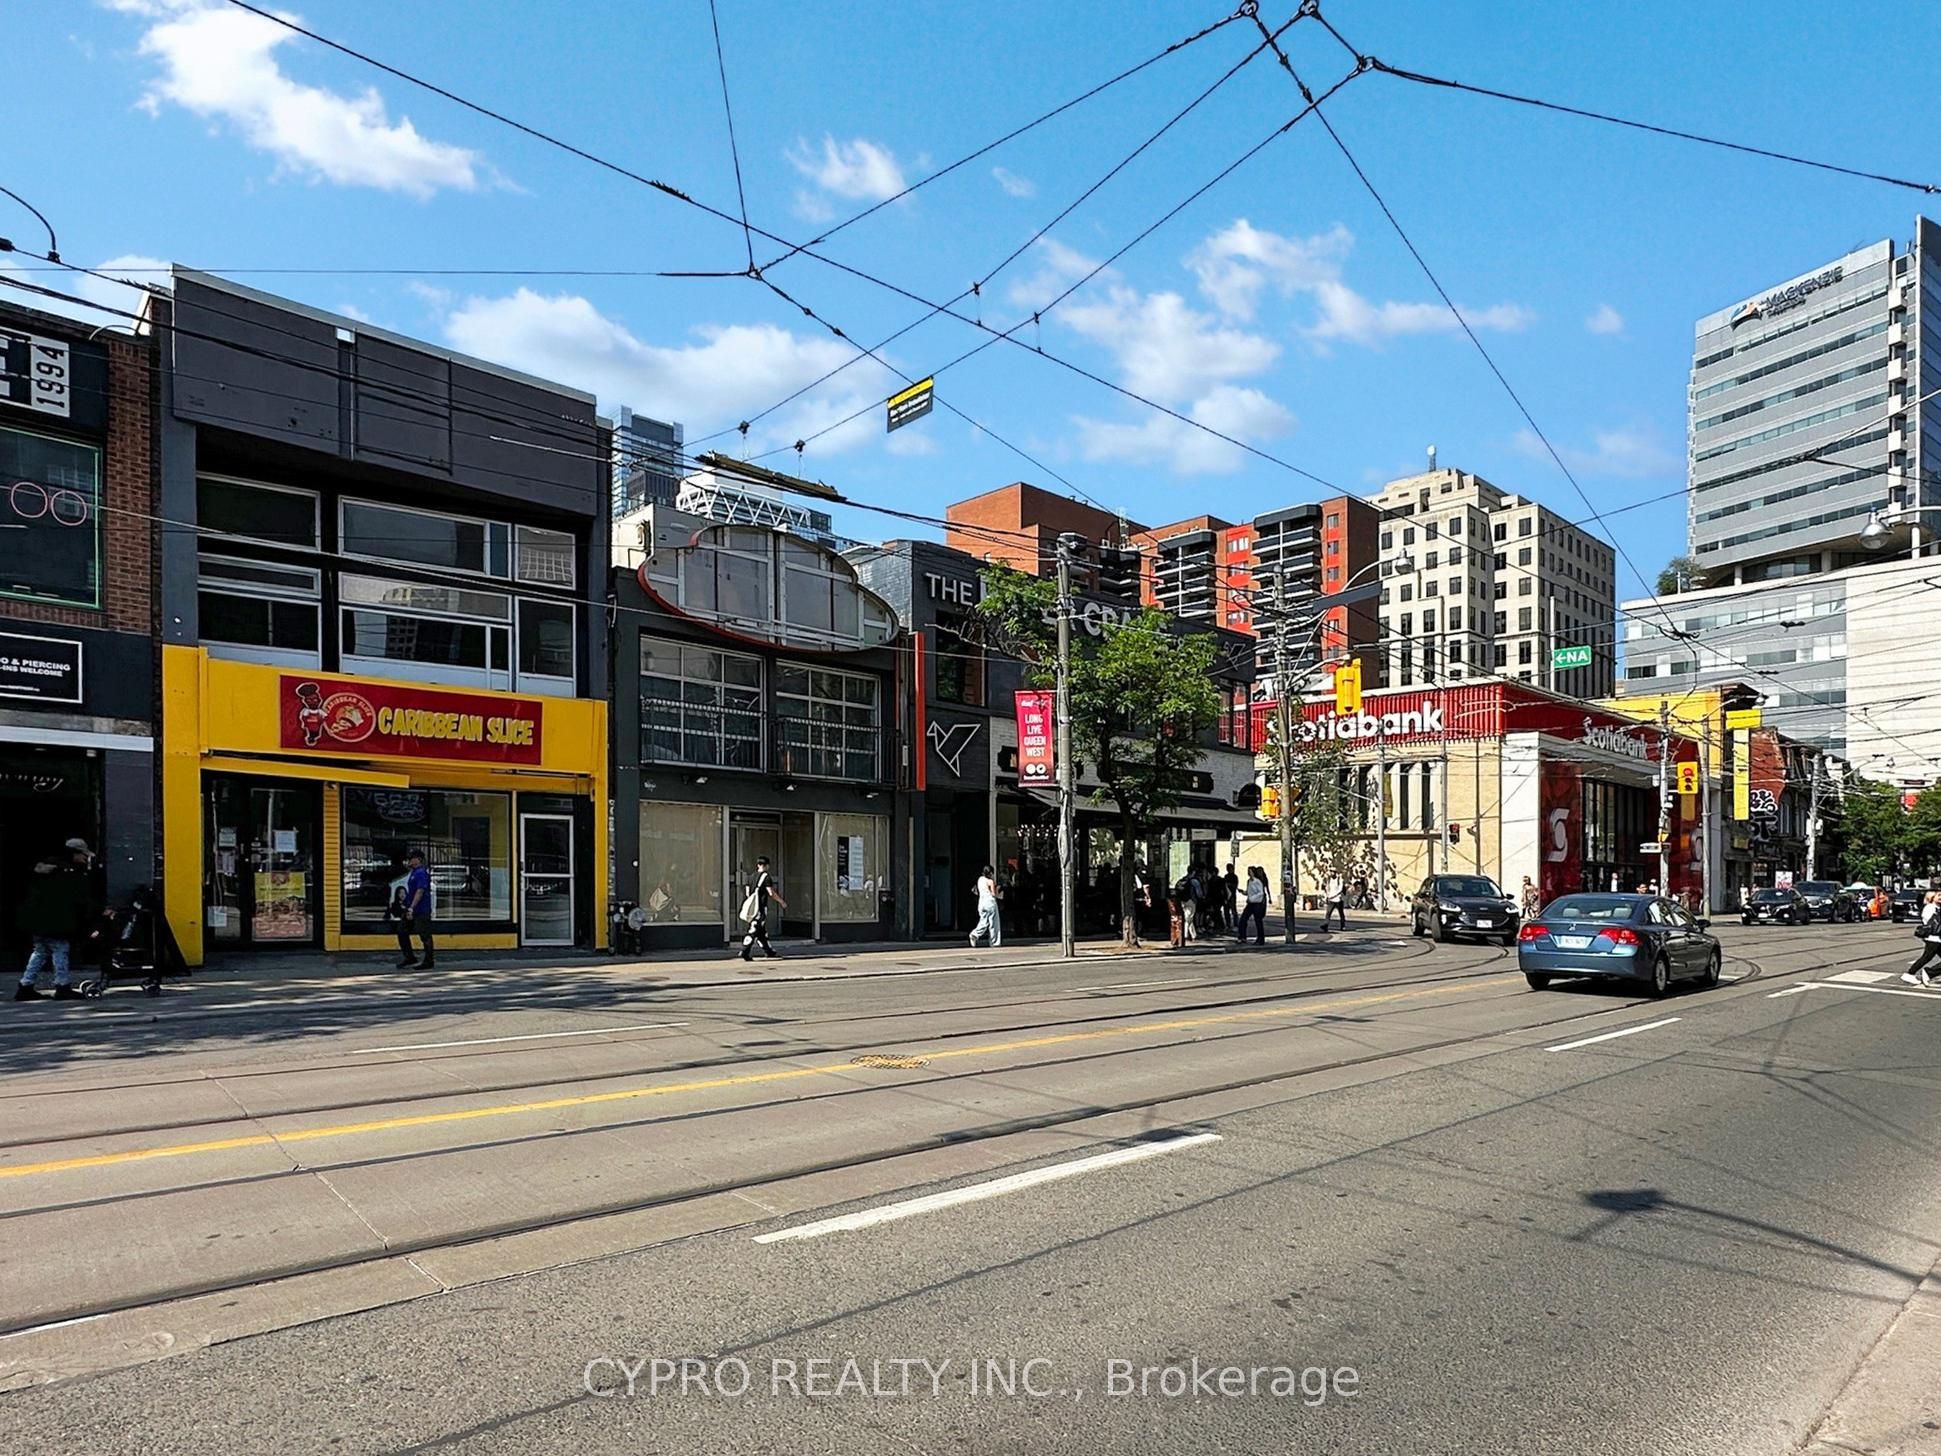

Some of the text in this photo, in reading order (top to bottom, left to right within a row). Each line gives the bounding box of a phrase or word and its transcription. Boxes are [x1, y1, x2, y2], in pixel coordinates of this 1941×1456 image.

[35, 345, 66, 408] 1994
[924, 572, 974, 607] THE
[1567, 650, 1588, 664] NA
[22, 659, 71, 671] PIERCING
[20, 666, 63, 677] WELCOME
[1024, 713, 1044, 724] LONG
[377, 706, 535, 746] CARIBBEAN SLICE
[1027, 725, 1043, 735] LIVE
[1023, 736, 1047, 746] QUEEN
[1583, 716, 1648, 760] Scotiabank
[1026, 747, 1045, 758] WEST
